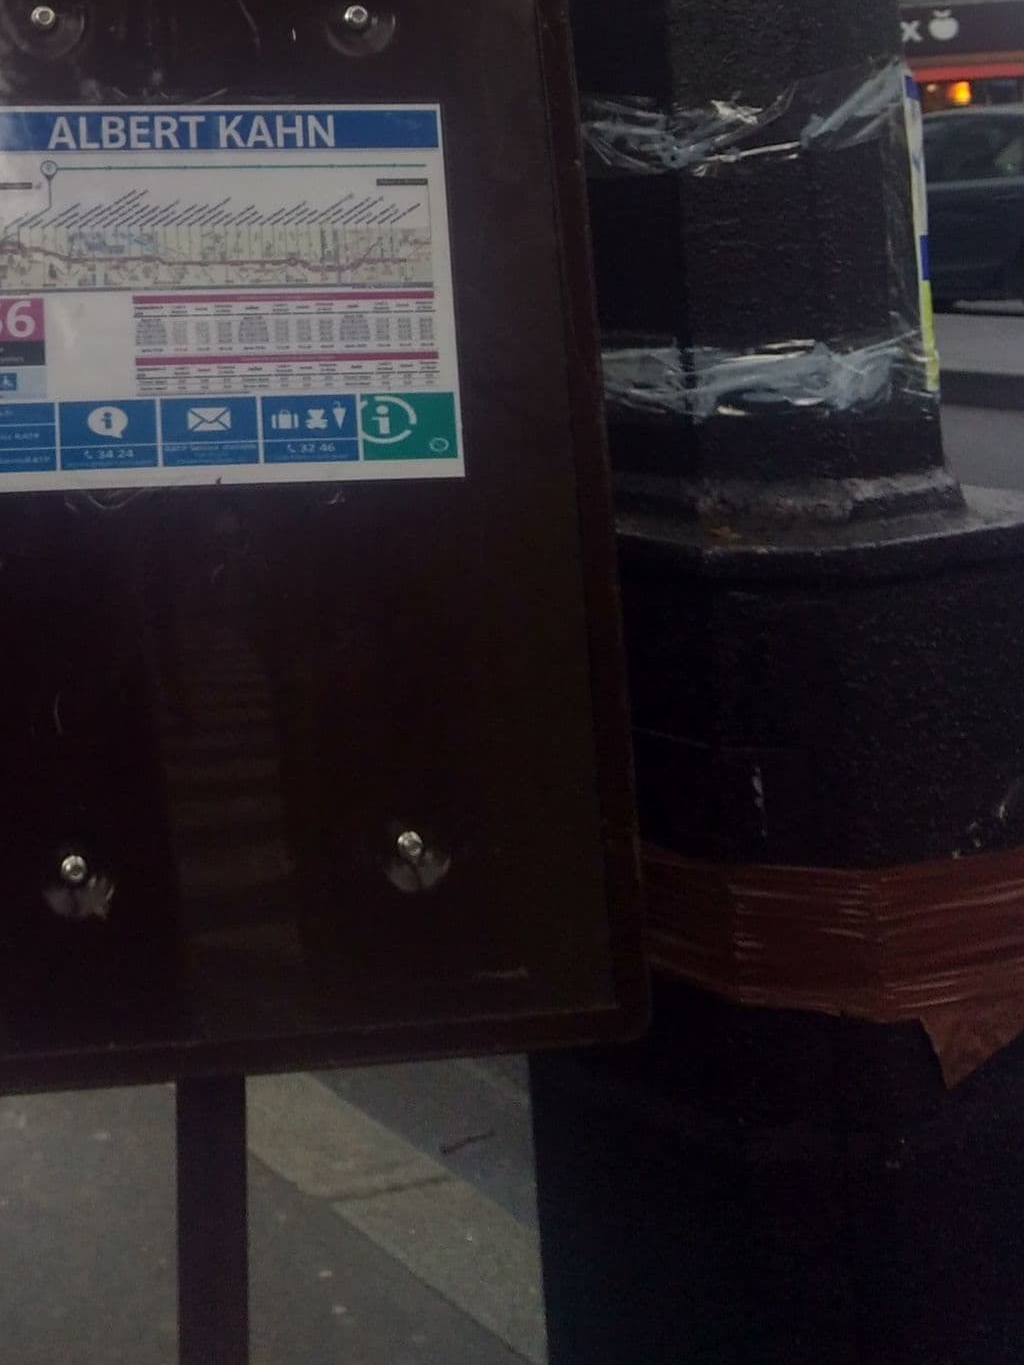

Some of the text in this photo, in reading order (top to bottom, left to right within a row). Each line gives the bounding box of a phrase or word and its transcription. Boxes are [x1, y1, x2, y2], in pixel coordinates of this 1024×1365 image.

[47, 114, 336, 149] ALBERT KAHN
[319, 442, 336, 453] 46
